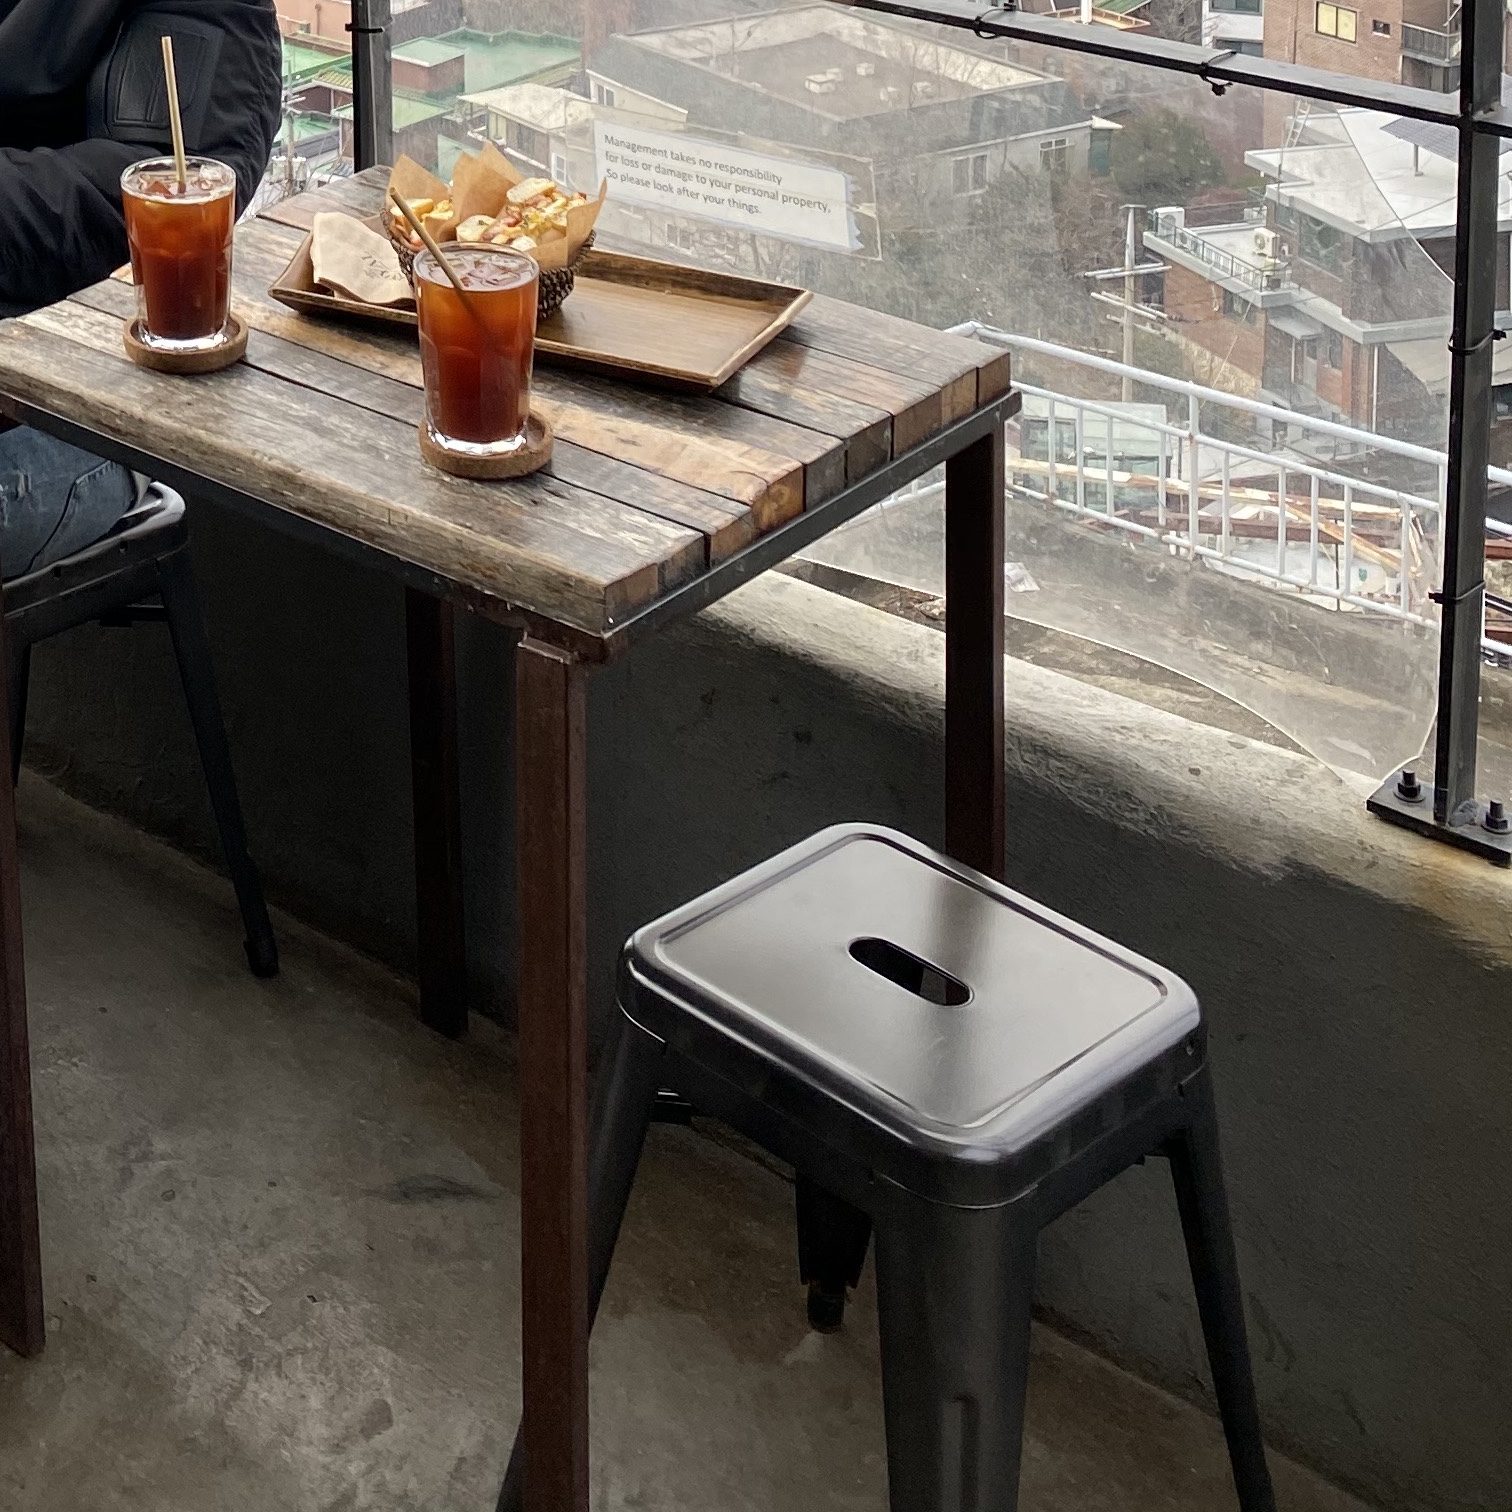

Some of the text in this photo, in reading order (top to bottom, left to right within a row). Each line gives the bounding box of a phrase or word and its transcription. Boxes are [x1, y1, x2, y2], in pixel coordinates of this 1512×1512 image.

[604, 134, 782, 185] Management takes no responsibility
[605, 150, 619, 164] for
[621, 155, 639, 169] loss
[641, 162, 652, 171] or
[654, 164, 694, 182] damage
[696, 174, 706, 185] to
[709, 178, 732, 191] your
[734, 183, 778, 201] personal
[606, 168, 618, 180] So
[620, 172, 651, 189] please
[653, 179, 675, 194] look
[676, 186, 700, 200] after
[702, 192, 725, 205] your
